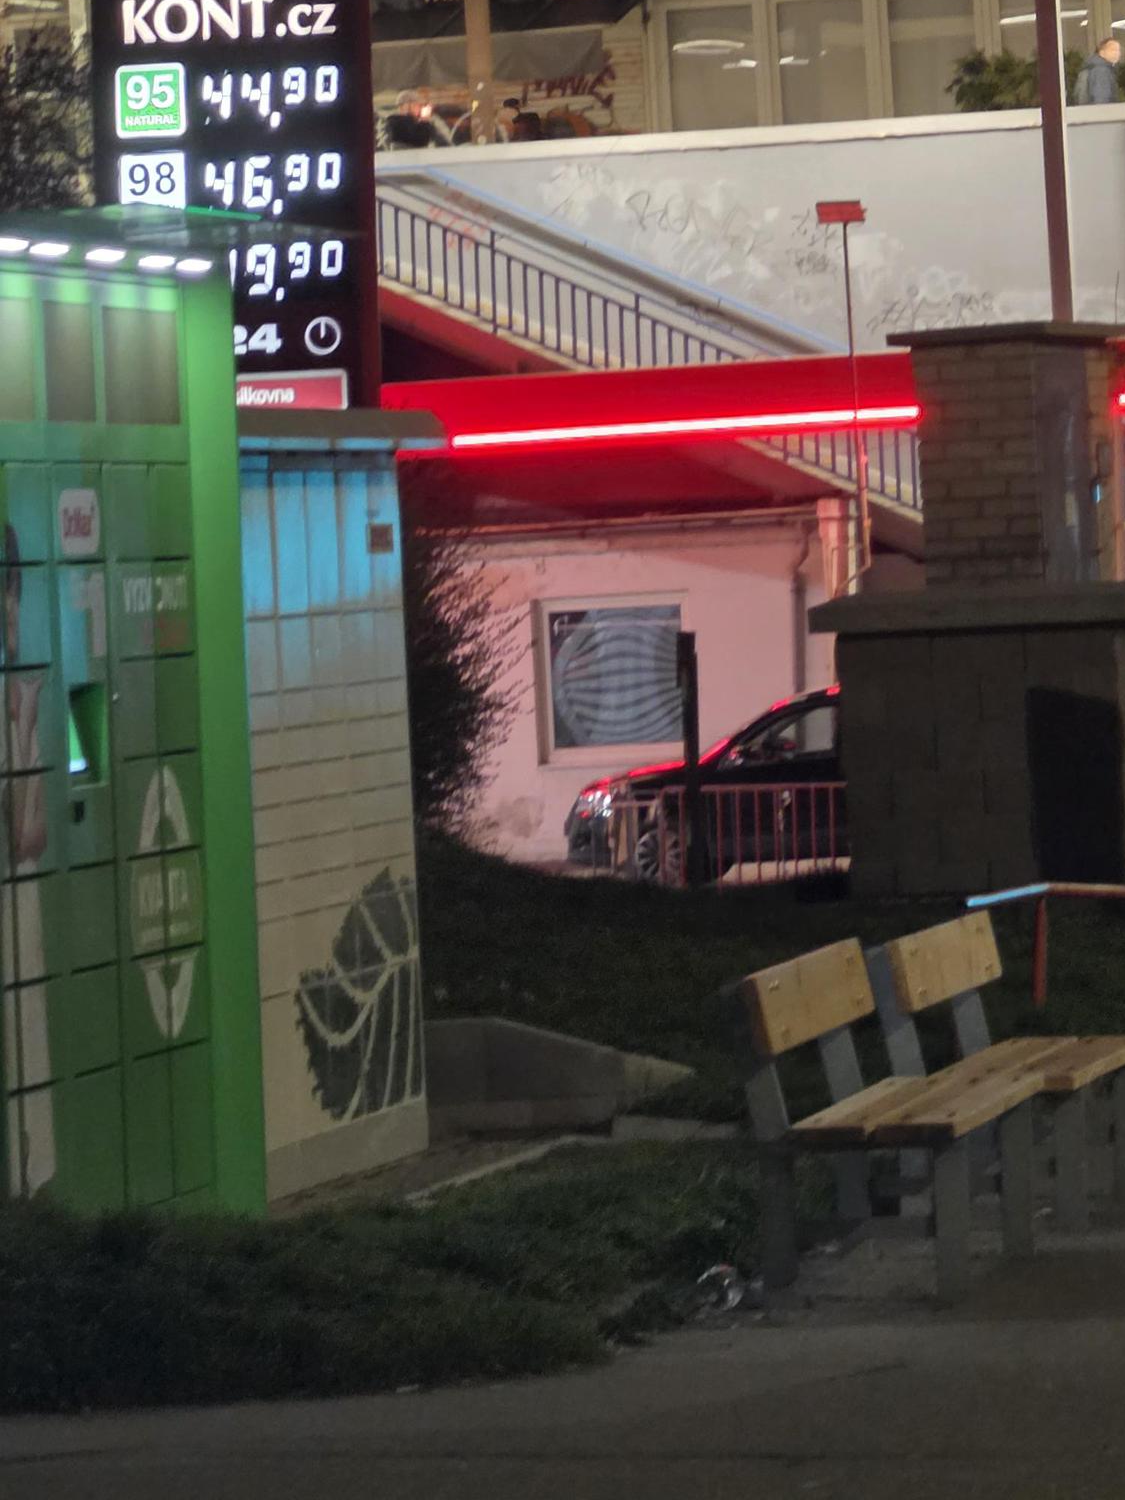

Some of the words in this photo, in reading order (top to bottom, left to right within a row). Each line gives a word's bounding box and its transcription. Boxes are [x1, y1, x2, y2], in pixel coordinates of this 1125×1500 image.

[126, 73, 176, 110] 95
[125, 113, 177, 127] NATURAL
[128, 161, 176, 196] 98
[204, 152, 341, 215] 46,90
